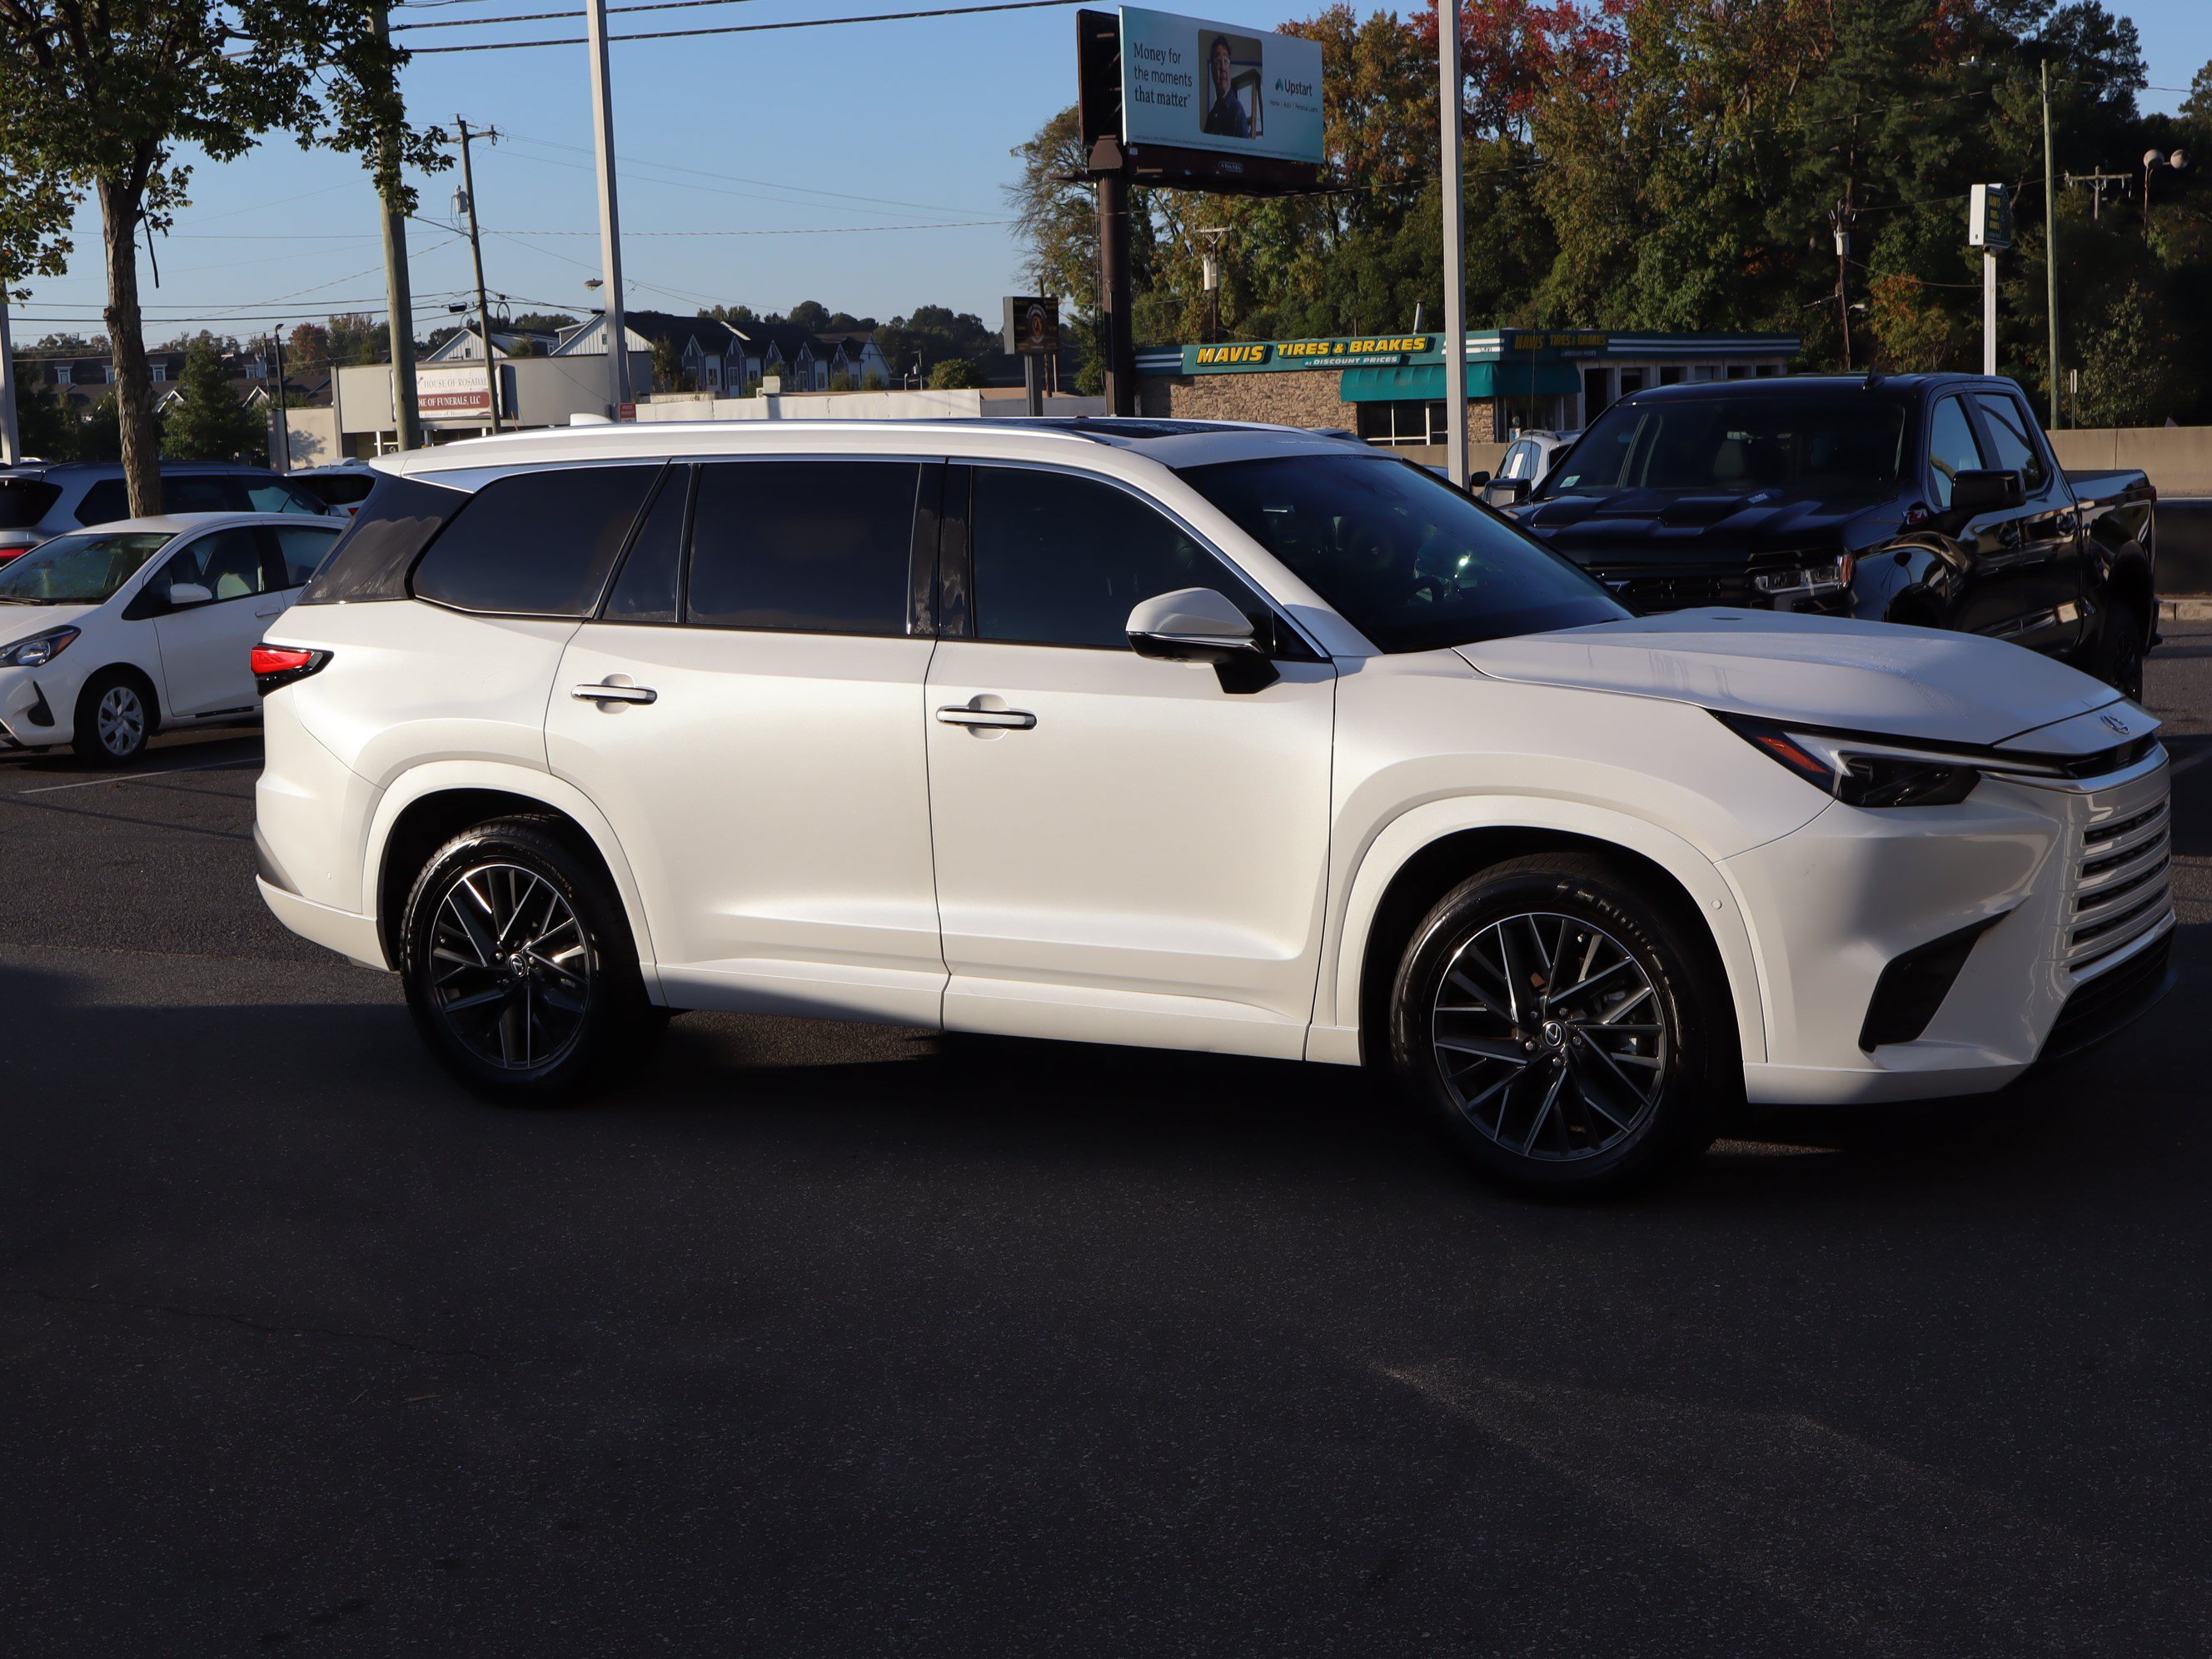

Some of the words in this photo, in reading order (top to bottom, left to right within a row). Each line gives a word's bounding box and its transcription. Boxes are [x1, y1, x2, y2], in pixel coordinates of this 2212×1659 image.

[1133, 42, 1166, 67] Money
[1168, 47, 1182, 63] for
[1134, 66, 1149, 81] the
[1151, 71, 1193, 87] moments
[1134, 87, 1154, 103] that
[1284, 78, 1313, 97] Upstart
[1196, 345, 1264, 365] MAVIS
[1277, 341, 1330, 356] TIRES
[1334, 342, 1345, 354] &
[1349, 336, 1427, 354] BRAKES
[1313, 357, 1361, 366] DISCOUNT
[1363, 355, 1398, 364] PRICES
[424, 379, 446, 389] HOUSE
[447, 378, 456, 387] OF
[458, 376, 487, 386] ROSADAL
[418, 398, 427, 407] ME
[427, 397, 437, 406] OF
[470, 396, 481, 405] LLC
